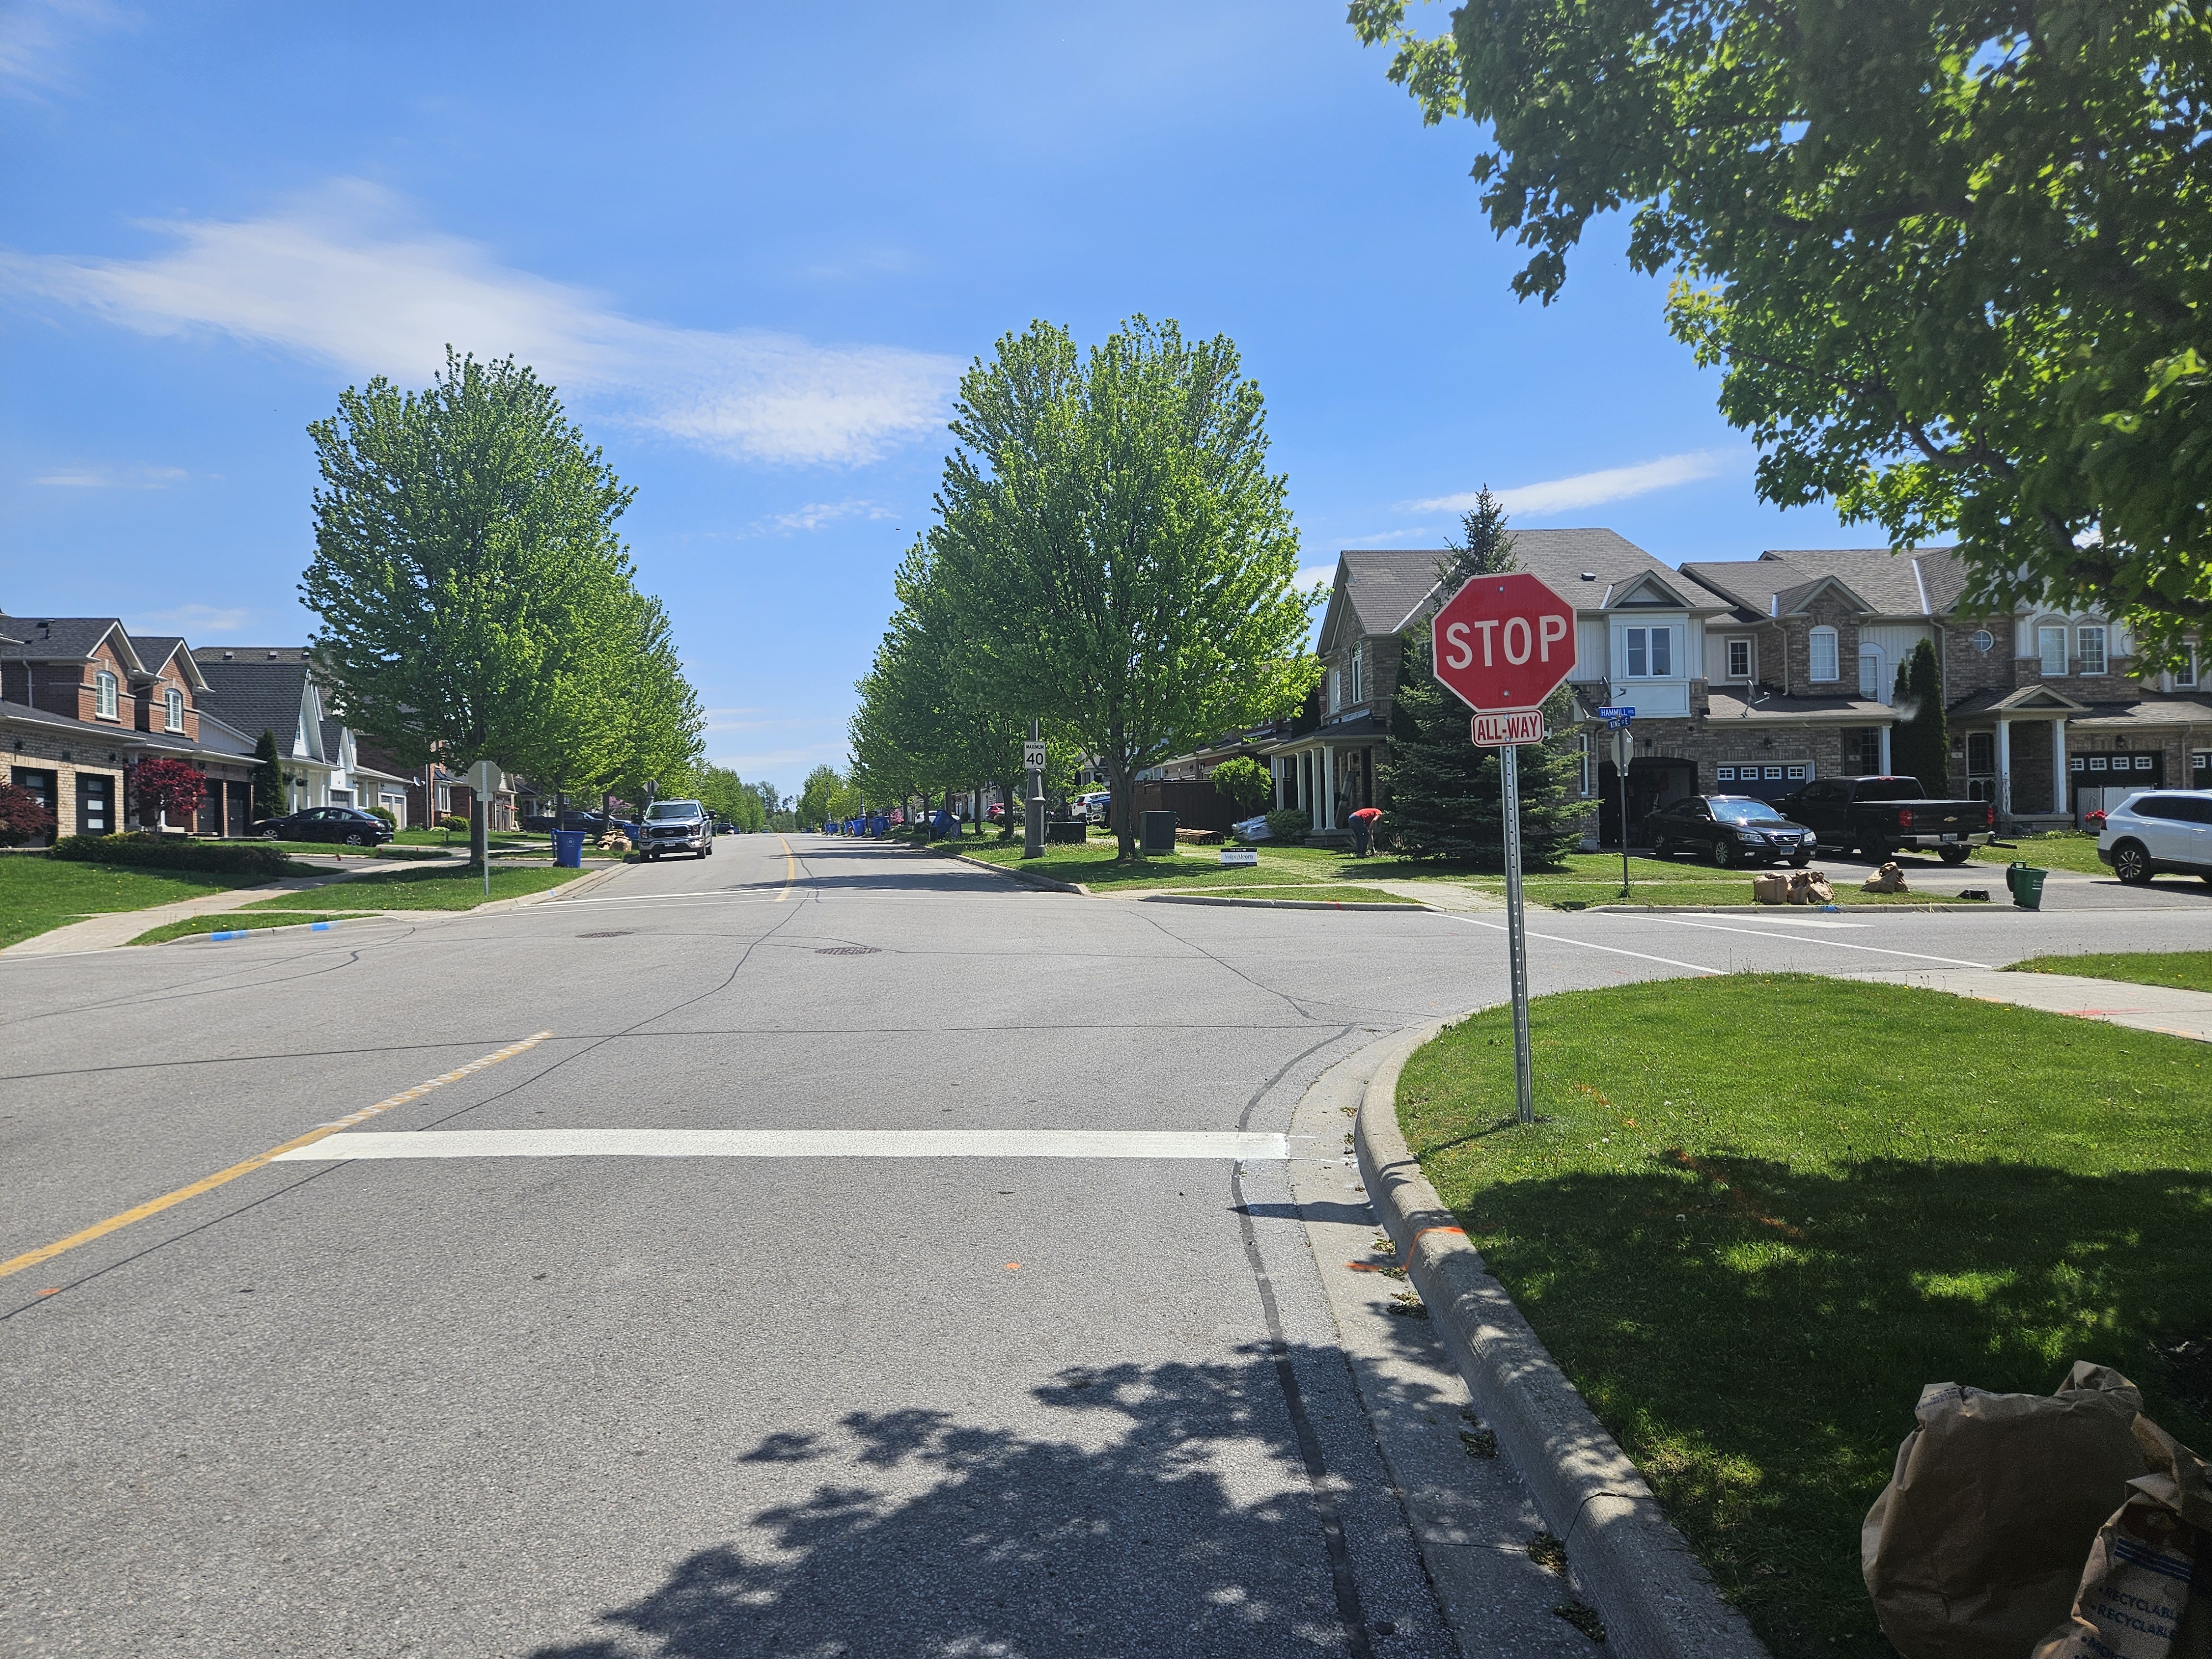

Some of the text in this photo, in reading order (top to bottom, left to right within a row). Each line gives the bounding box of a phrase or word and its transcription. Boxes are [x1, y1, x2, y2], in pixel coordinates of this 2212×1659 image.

[1446, 614, 1567, 670] STOP
[1601, 708, 1627, 717] HAMMILL
[1477, 715, 1538, 741] ALL-WAY
[1610, 719, 1620, 728] KING
[1026, 753, 1044, 765] 40
